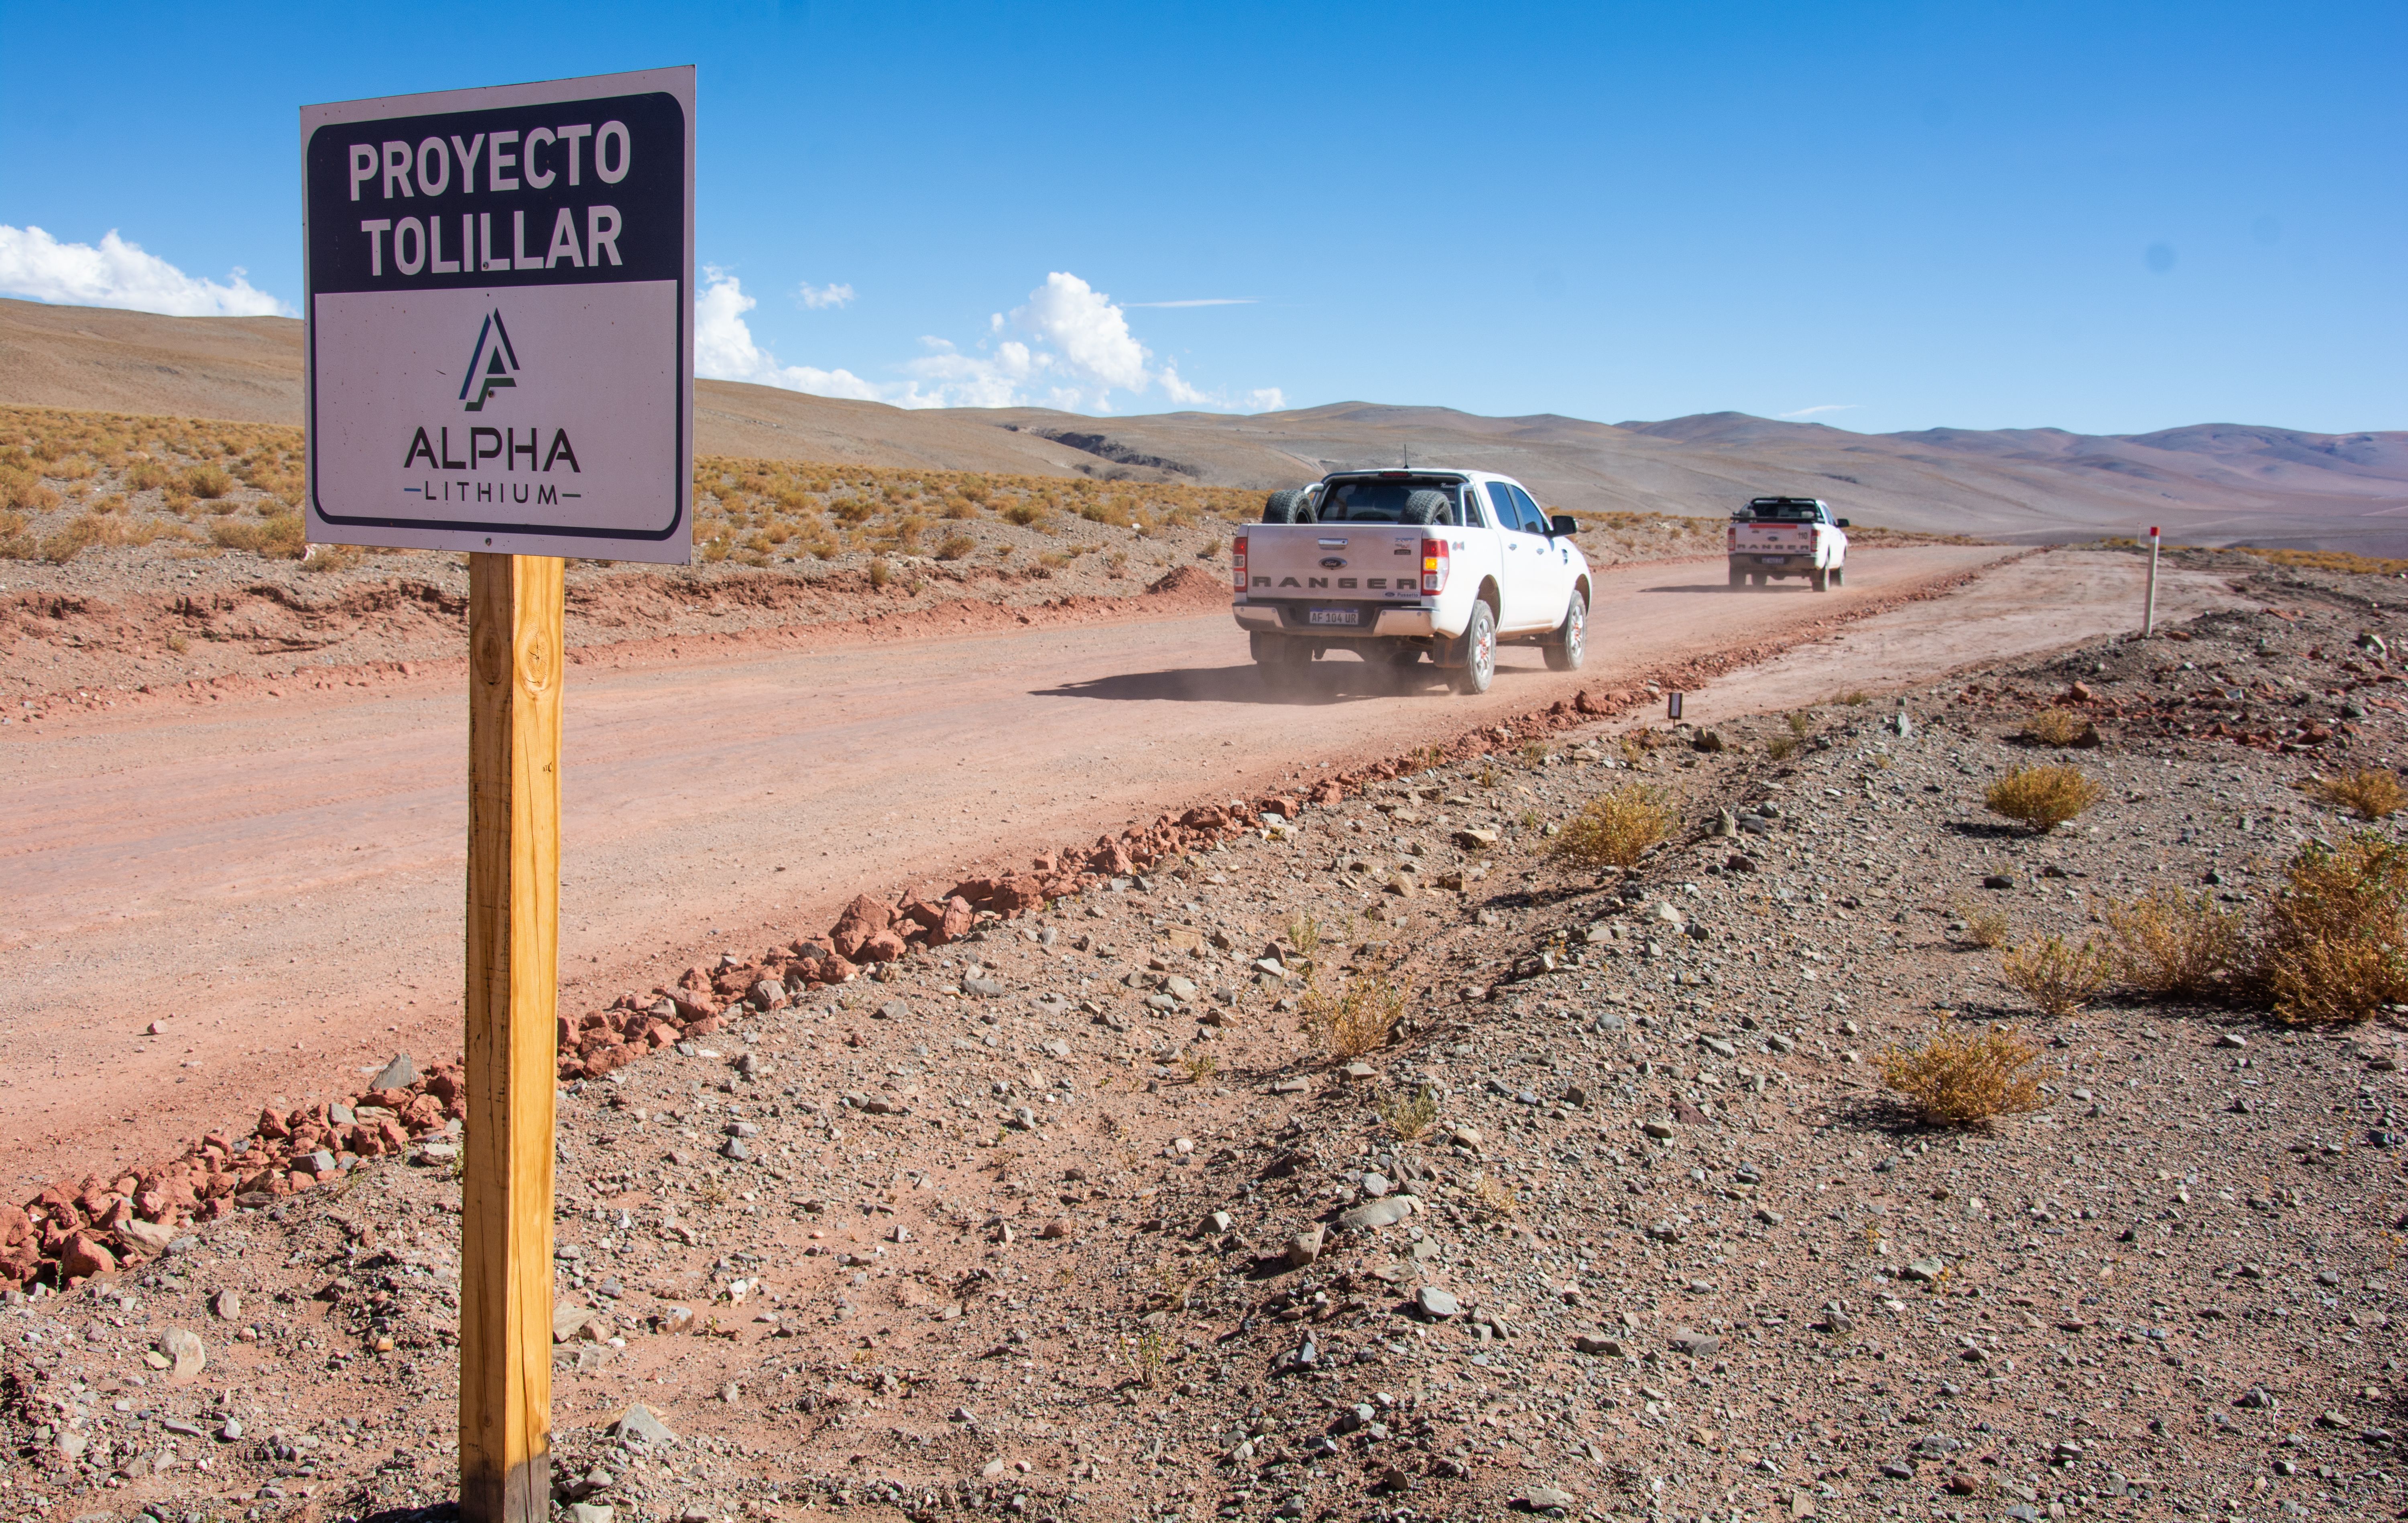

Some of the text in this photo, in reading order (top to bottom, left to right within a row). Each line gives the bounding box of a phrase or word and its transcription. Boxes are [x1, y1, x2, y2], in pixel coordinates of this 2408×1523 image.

[350, 121, 630, 201] PROYECTO
[362, 205, 622, 276] TOLILLAR
[404, 427, 581, 473] ALPHA
[425, 480, 558, 505] LITHIUM
[1252, 576, 1417, 590] RANGER
[1312, 612, 1356, 623] AF 104 UR
